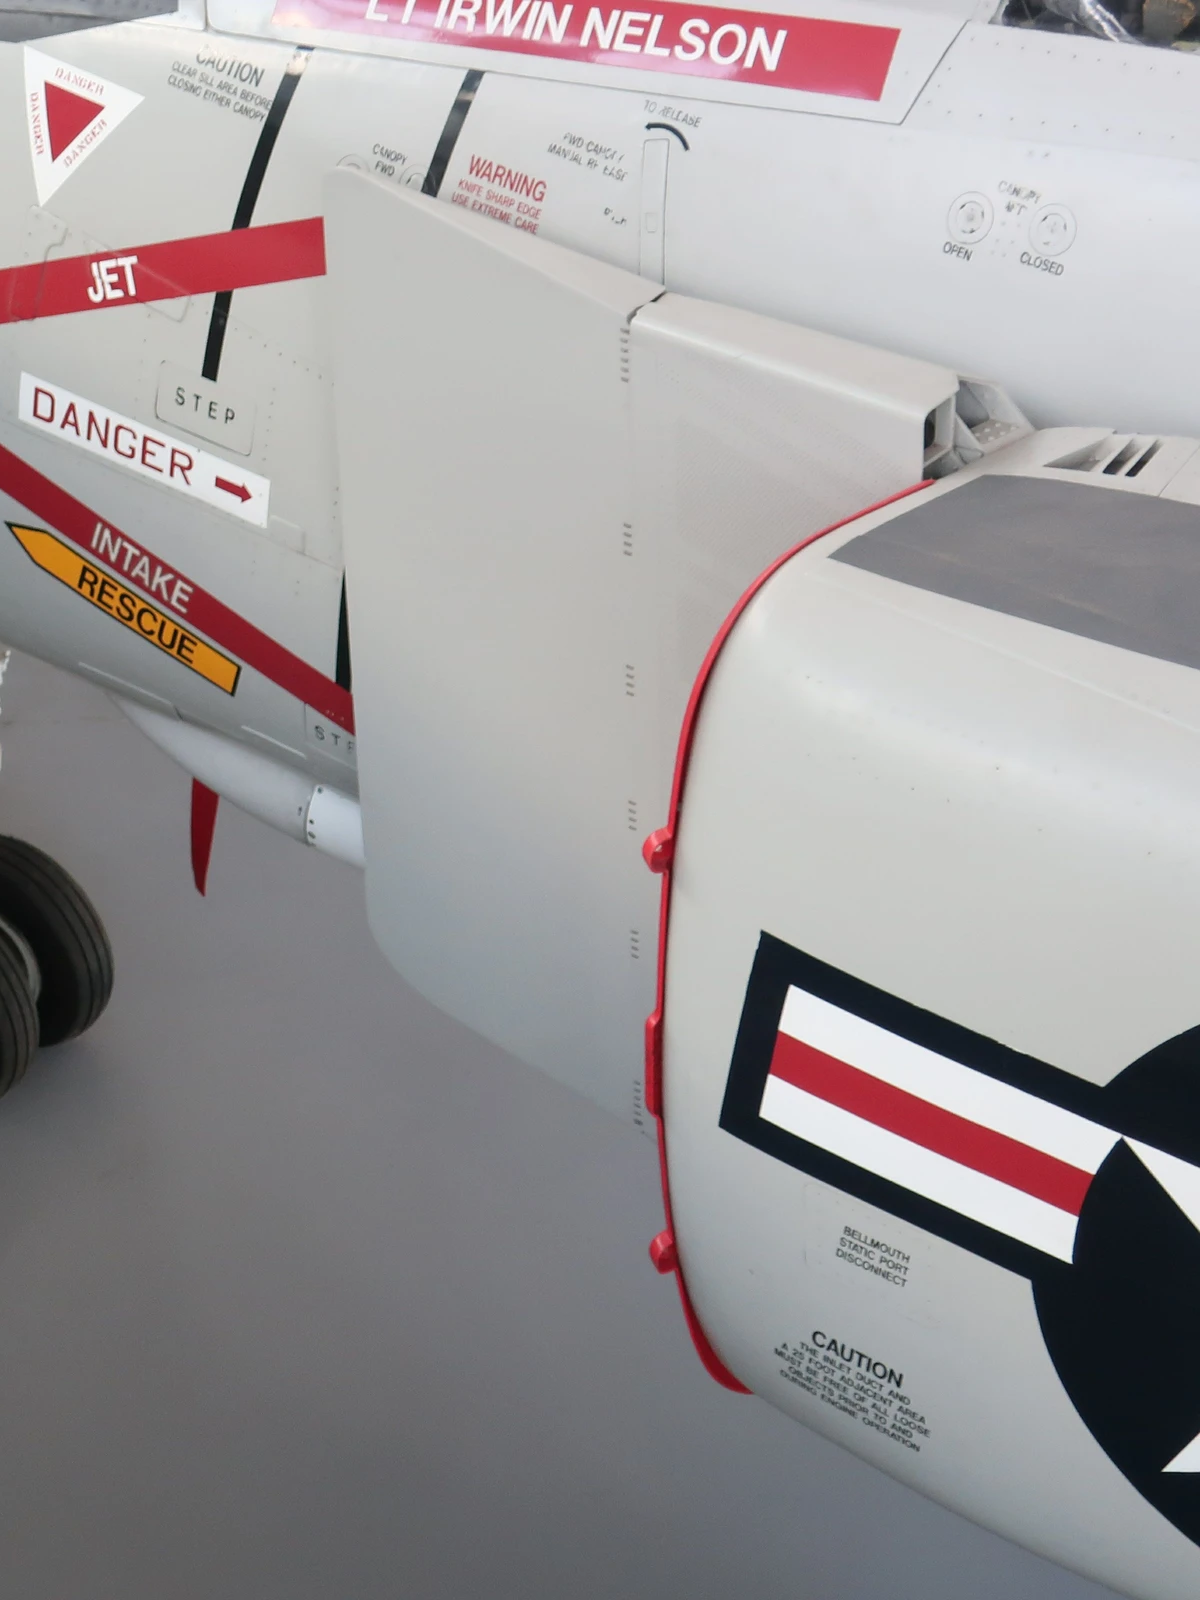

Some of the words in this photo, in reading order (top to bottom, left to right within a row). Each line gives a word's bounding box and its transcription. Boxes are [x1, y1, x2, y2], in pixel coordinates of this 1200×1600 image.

[434, 0, 573, 44] IRWIN
[579, 7, 788, 72] NELSON
[55, 67, 105, 96] DANGER
[171, 60, 198, 78] CLEAR
[199, 71, 215, 87] SILL
[216, 79, 238, 97] AREA
[239, 88, 274, 111] BEFORE
[196, 52, 266, 88] CAUTION
[167, 74, 202, 98] CLOSING
[203, 89, 232, 109] EITHER
[233, 101, 266, 123] CANOPY
[643, 99, 658, 113] TO
[658, 105, 703, 129] RELEASE
[30, 92, 45, 156] DANGER
[63, 119, 108, 168] DANGER
[372, 142, 408, 166] CANOPY
[374, 160, 396, 177] FWD
[547, 142, 583, 166] MANUAL
[458, 178, 484, 198] KNIFE
[485, 189, 516, 209] SHARP
[516, 202, 543, 220] EDGE
[468, 154, 548, 203] WARNING
[451, 192, 471, 208] USE
[471, 202, 513, 226] EXTREME
[514, 216, 540, 235] CARE
[942, 241, 973, 262] OPEN
[1019, 251, 1065, 276] CLOSED
[87, 255, 138, 303] JET
[175, 387, 235, 424] STEP
[33, 386, 194, 486] DANGER
[90, 522, 194, 614] INTAKE
[77, 564, 198, 664] RESCUE
[314, 725, 356, 754] STE
[835, 1248, 908, 1288] DISCONNECT
[840, 1237, 875, 1260] STATIC
[879, 1255, 910, 1276] PORT
[843, 1226, 911, 1263] BELLMOUTH
[800, 1341, 820, 1357] THE
[822, 1354, 852, 1374] INLET
[855, 1371, 884, 1392] DUCT
[888, 1389, 911, 1406] AND
[811, 1331, 904, 1389] CAUTION
[773, 1347, 802, 1368] MUST
[805, 1366, 821, 1379] BE
[823, 1375, 850, 1395] FREE
[853, 1391, 869, 1404] OF
[871, 1401, 890, 1418] ALL
[894, 1412, 932, 1439] LOOSE
[788, 1365, 834, 1397] OBJECTS
[838, 1393, 870, 1416] PRIOR
[873, 1411, 888, 1426] TO
[890, 1422, 914, 1440] AND
[792, 1348, 805, 1361] 25
[808, 1356, 837, 1377] FOOT
[839, 1375, 894, 1408] ADJACENT
[897, 1405, 926, 1425] AREA
[779, 1369, 818, 1397] DURING
[820, 1393, 859, 1420] ENGINE
[862, 1416, 921, 1453] OPERATION
